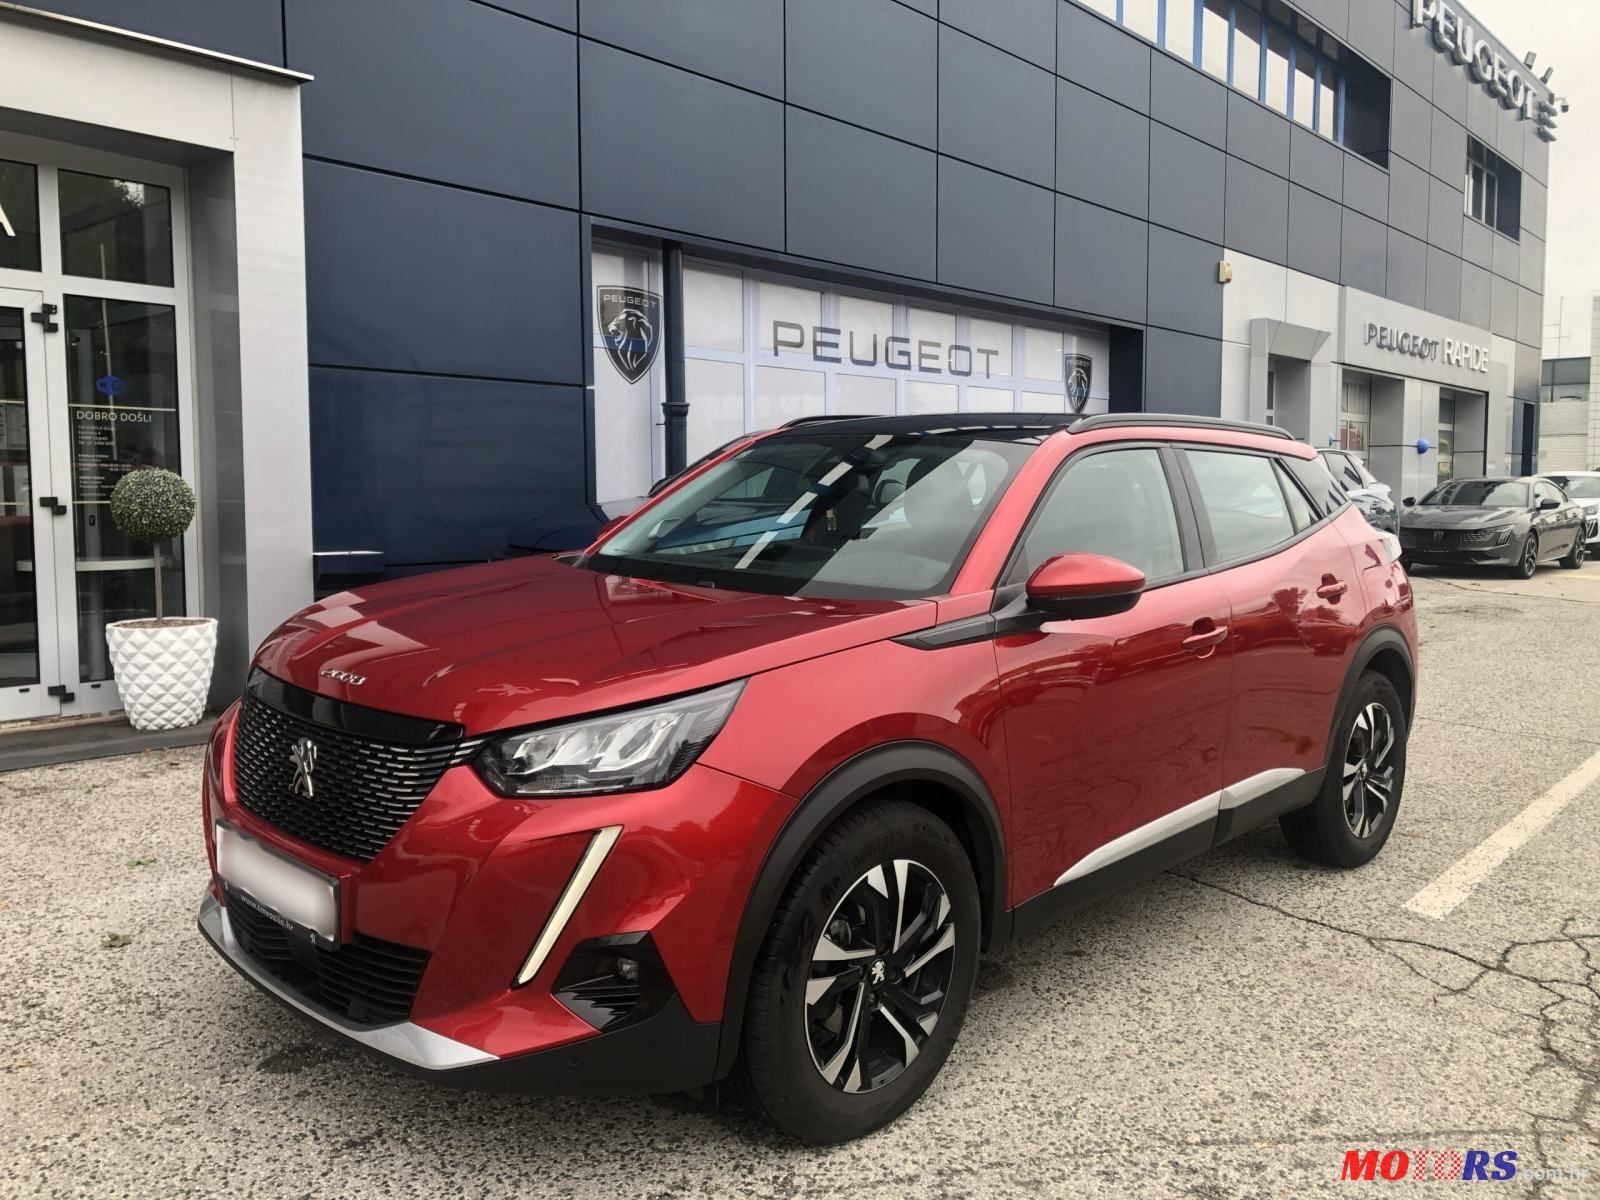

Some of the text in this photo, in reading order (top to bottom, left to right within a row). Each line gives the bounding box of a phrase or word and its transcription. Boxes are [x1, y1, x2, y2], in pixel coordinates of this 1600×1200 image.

[1410, 0, 1538, 120] PEUGEOT
[603, 294, 657, 309] PEUGEOT
[772, 319, 999, 380] PEUGEOT
[1364, 322, 1489, 374] PEUGEOT RAPIDE
[76, 410, 152, 422] DOBRO DOŠLI
